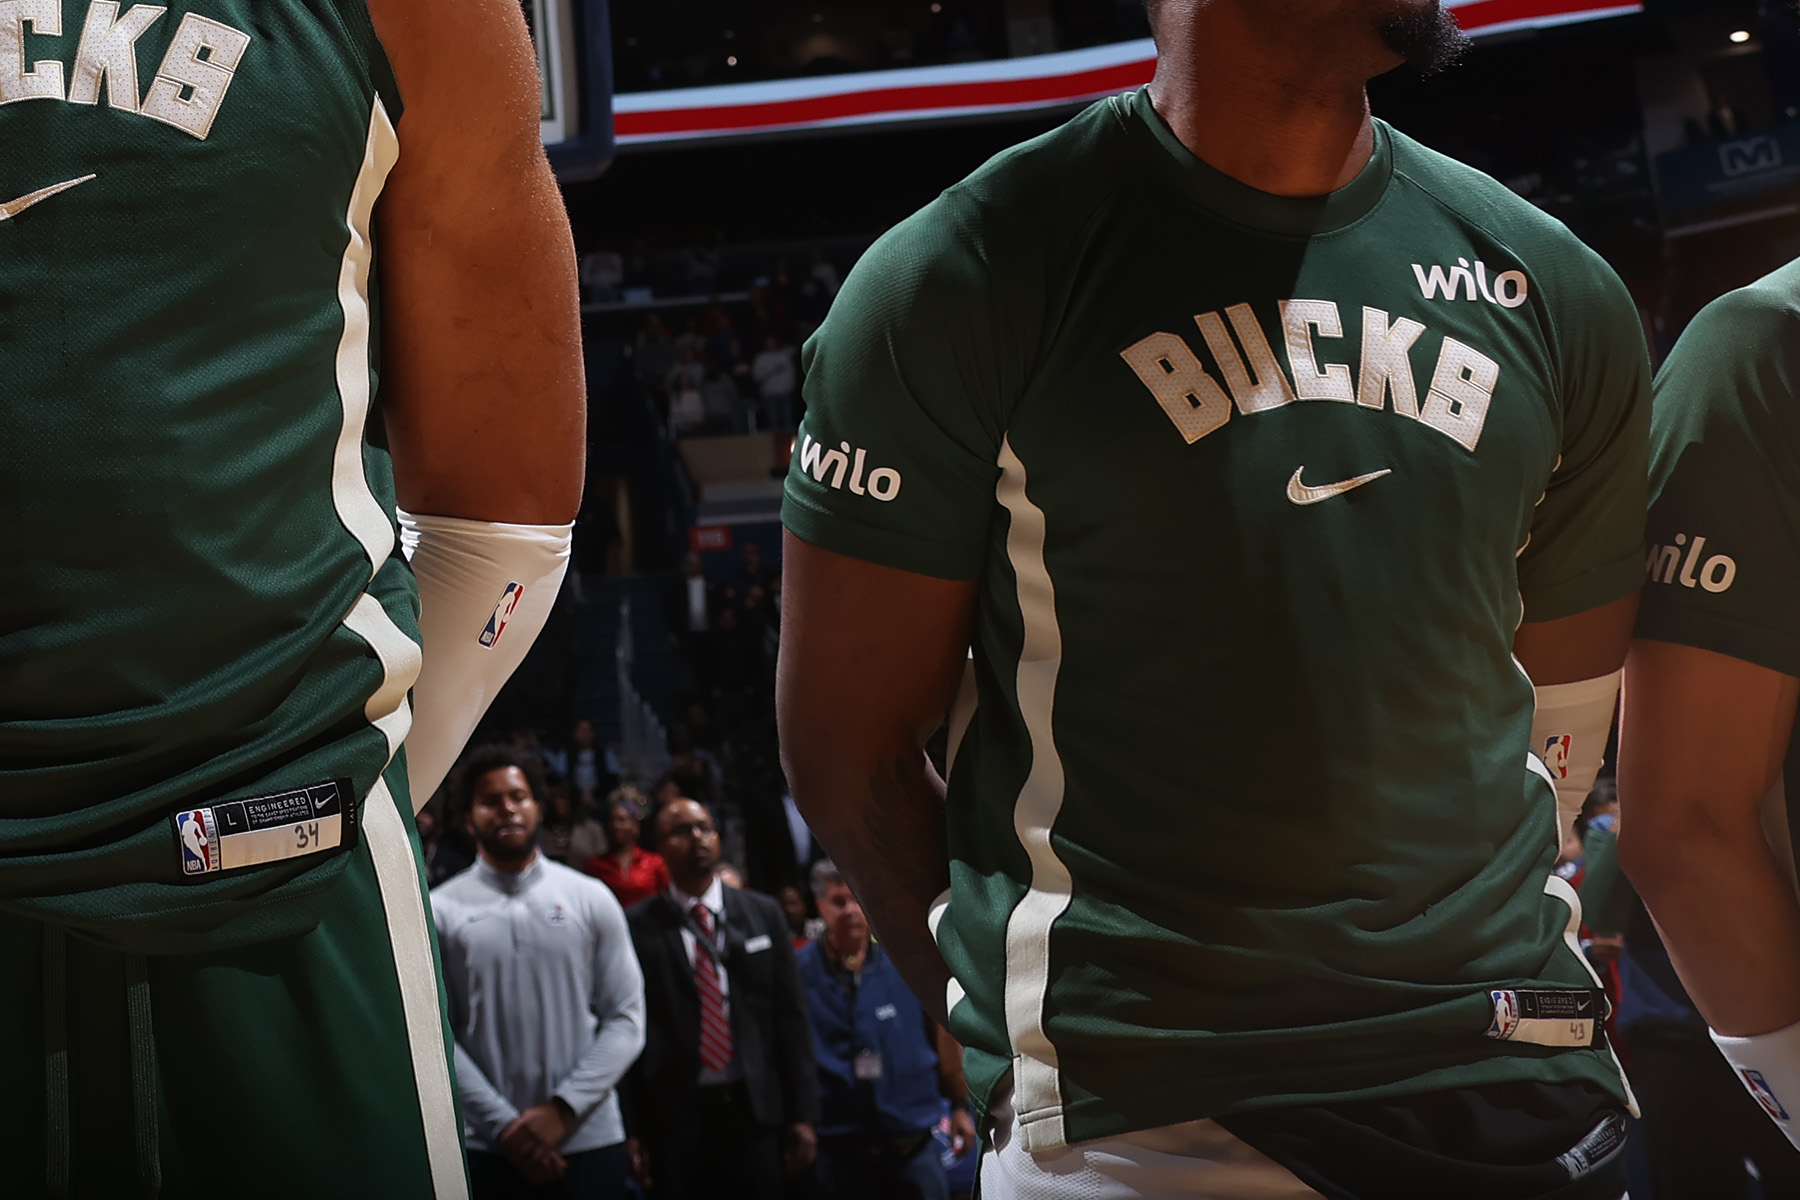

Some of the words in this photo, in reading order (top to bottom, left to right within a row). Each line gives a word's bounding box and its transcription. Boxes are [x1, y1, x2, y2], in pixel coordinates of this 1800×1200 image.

[1411, 258, 1528, 308] wilo
[1118, 297, 1501, 452] BUCKS
[800, 433, 902, 502] wilo
[249, 796, 306, 814] ENGINEERED
[226, 813, 237, 827] L
[295, 822, 319, 849] 34
[187, 859, 201, 872] NBA
[1570, 1021, 1586, 1041] 43
